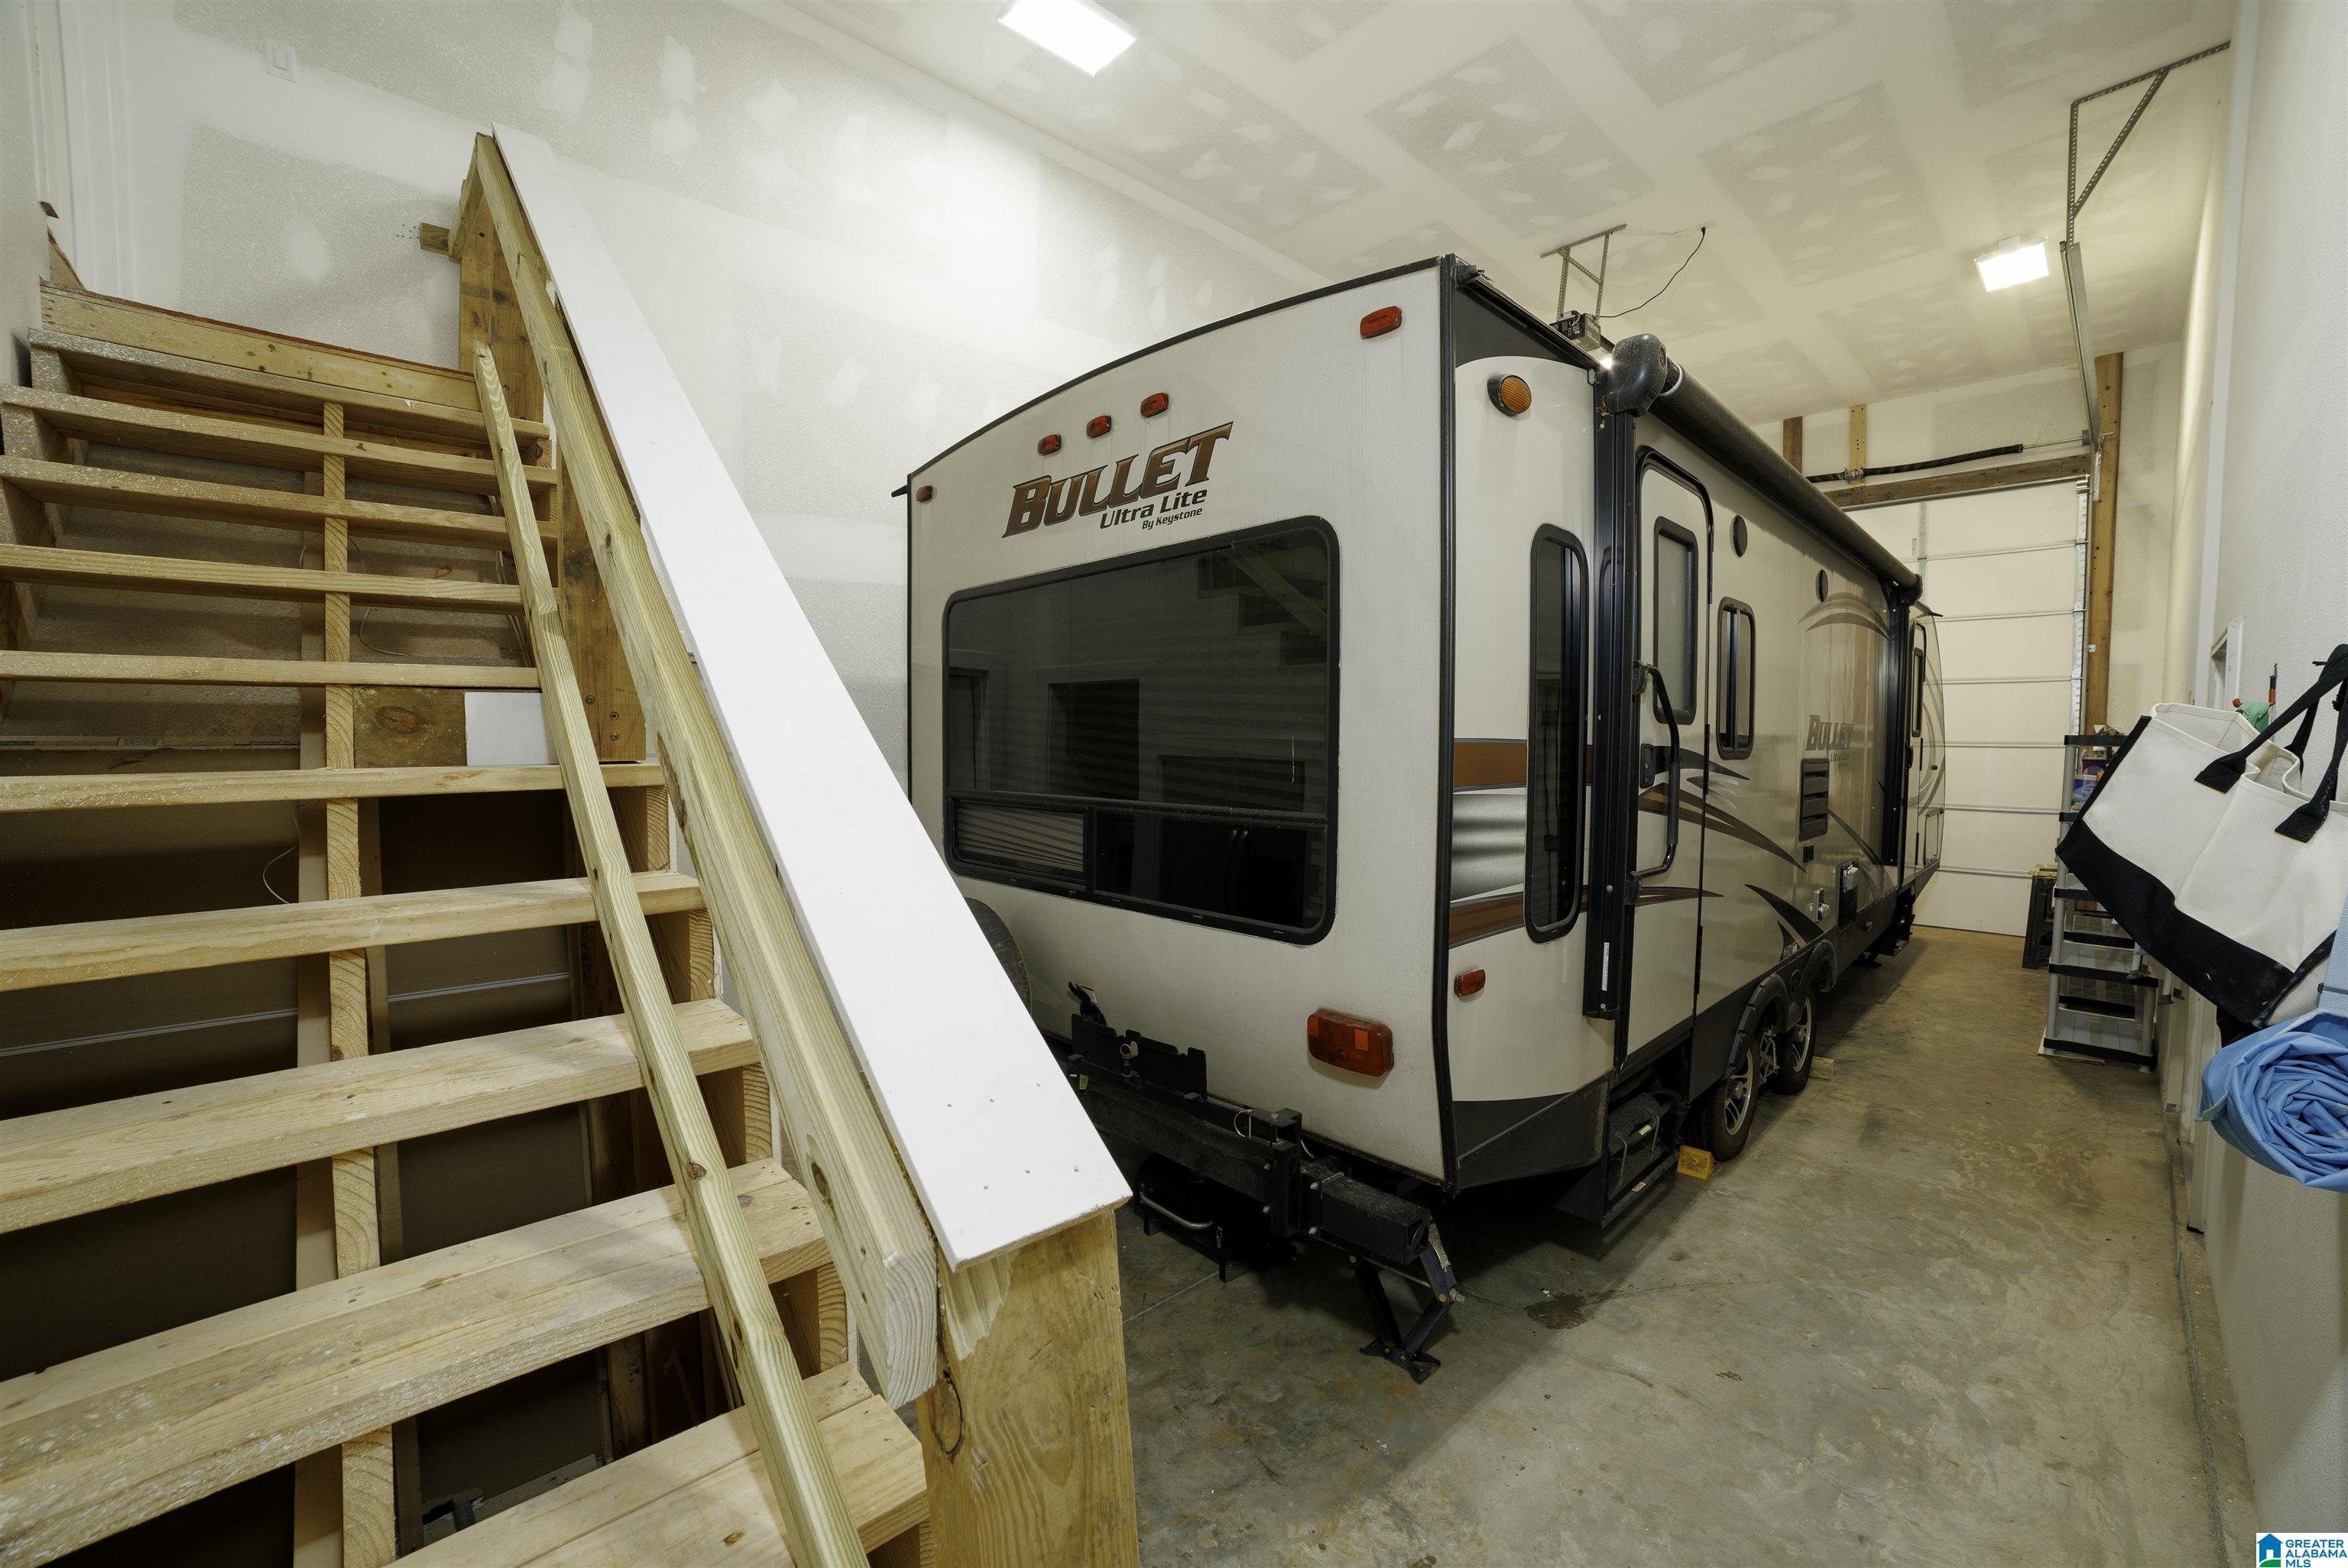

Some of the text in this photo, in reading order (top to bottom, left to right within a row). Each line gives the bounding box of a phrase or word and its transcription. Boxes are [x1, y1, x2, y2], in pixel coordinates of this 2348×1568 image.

[1002, 421, 1234, 539] BULLET
[1100, 489, 1208, 529] Ultra Lite
[1142, 508, 1203, 530] By Keystone
[1805, 714, 1853, 751] BULLET
